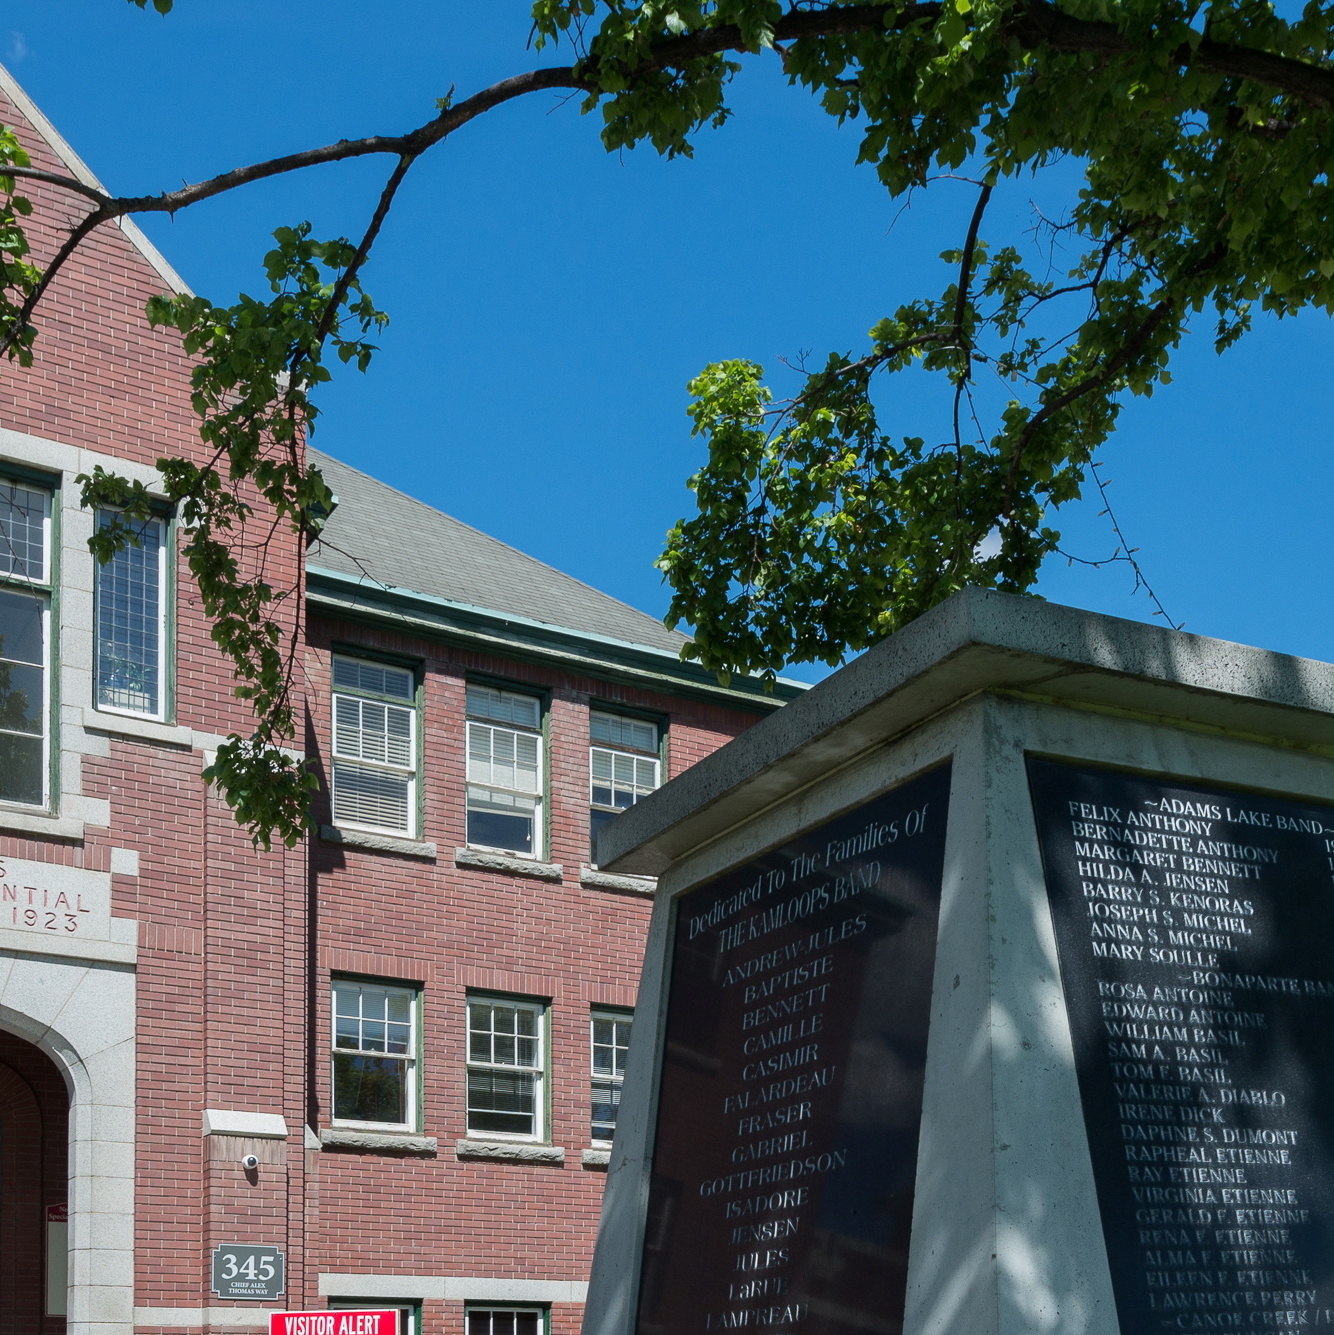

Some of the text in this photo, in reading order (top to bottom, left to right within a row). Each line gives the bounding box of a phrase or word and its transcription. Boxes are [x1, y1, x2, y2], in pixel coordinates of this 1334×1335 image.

[1068, 801, 1213, 838] FELIX ANTHONY
[1225, 807, 1273, 829] LAKE
[1071, 820, 1280, 864] BERNADETTE ANTHONY
[689, 803, 930, 942] Dedicated To The Families Of
[1074, 840, 1262, 880] MARGARET BENNETT
[1077, 860, 1231, 895] HILDA A. JENSEN
[719, 860, 882, 953] THE KAMLOOPS BAND
[1081, 880, 1255, 917] BARRY S. KENORAS
[12, 908, 79, 933] 1923
[1087, 901, 1252, 935] JOSEPH S. MICHEL
[1090, 921, 1238, 953] ANNA S. MICHEL
[1091, 940, 1220, 969] MARY SOULLE
[744, 954, 835, 1005] BAPTISTE
[742, 983, 831, 1031] BENNETT
[1097, 980, 1235, 1009] ROSA ANTOINE
[1102, 1001, 1268, 1030] EDWARD ANTOINE
[743, 1013, 824, 1056] CAMILLE
[1104, 1020, 1247, 1048] WILLIAM BASIL
[742, 1043, 819, 1082] CASIMIR
[1108, 1041, 1229, 1066] SAM A. BASIL
[1110, 1062, 1155, 1081] TOM
[1178, 1066, 1232, 1085] BASIL
[724, 1065, 836, 1115] FALARDEAU
[1113, 1082, 1286, 1107] VALERIE A. DIABLO
[738, 1101, 812, 1136] FRASER
[1117, 1102, 1226, 1124] IRENE DICK
[731, 1130, 813, 1163] GABRIEL
[1120, 1123, 1299, 1147] DAPHNE S. DUMONT
[1124, 1144, 1292, 1166] RAPHEAL ETIENNE
[699, 1148, 848, 1198] GOTTFRIEDSON
[1127, 1164, 1247, 1185] RAY ETIENNE
[725, 1186, 809, 1219] ISADORE
[1131, 1186, 1299, 1206] VIRGINIA ETIENNE
[728, 1216, 801, 1246] JENSEN
[1135, 1207, 1213, 1225] GERALD
[1235, 1208, 1312, 1226] ETIENNE
[221, 1254, 275, 1281] 345
[732, 1248, 789, 1273] JULES
[728, 1277, 789, 1301] LaRUE
[1148, 1289, 1318, 1309] LAWRENCE PERRY
[338, 1314, 381, 1335] ALERT
[706, 1303, 810, 1330] LAMPREAU
